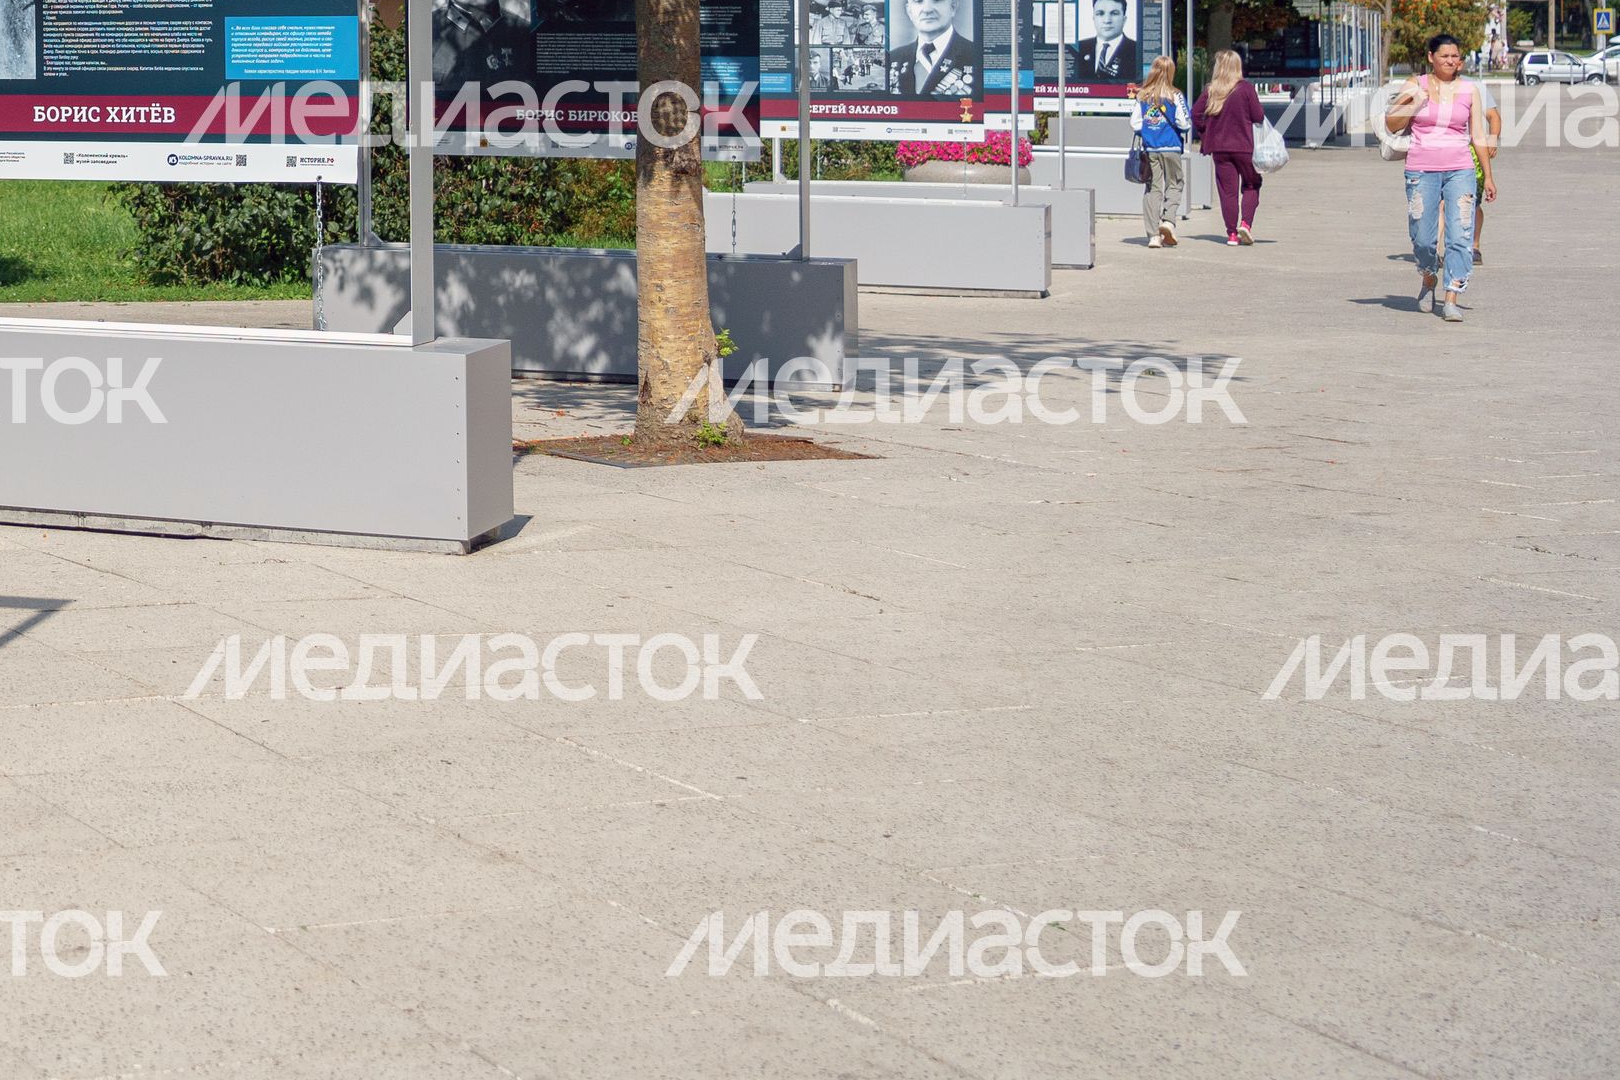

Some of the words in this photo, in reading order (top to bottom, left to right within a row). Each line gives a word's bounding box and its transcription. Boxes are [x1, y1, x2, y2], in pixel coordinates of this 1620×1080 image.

[33, 106, 100, 123] БОРИС
[106, 104, 176, 123] ХИТЁВ
[516, 109, 564, 121] БОРИС
[848, 105, 898, 115] ЗАХАРОВ
